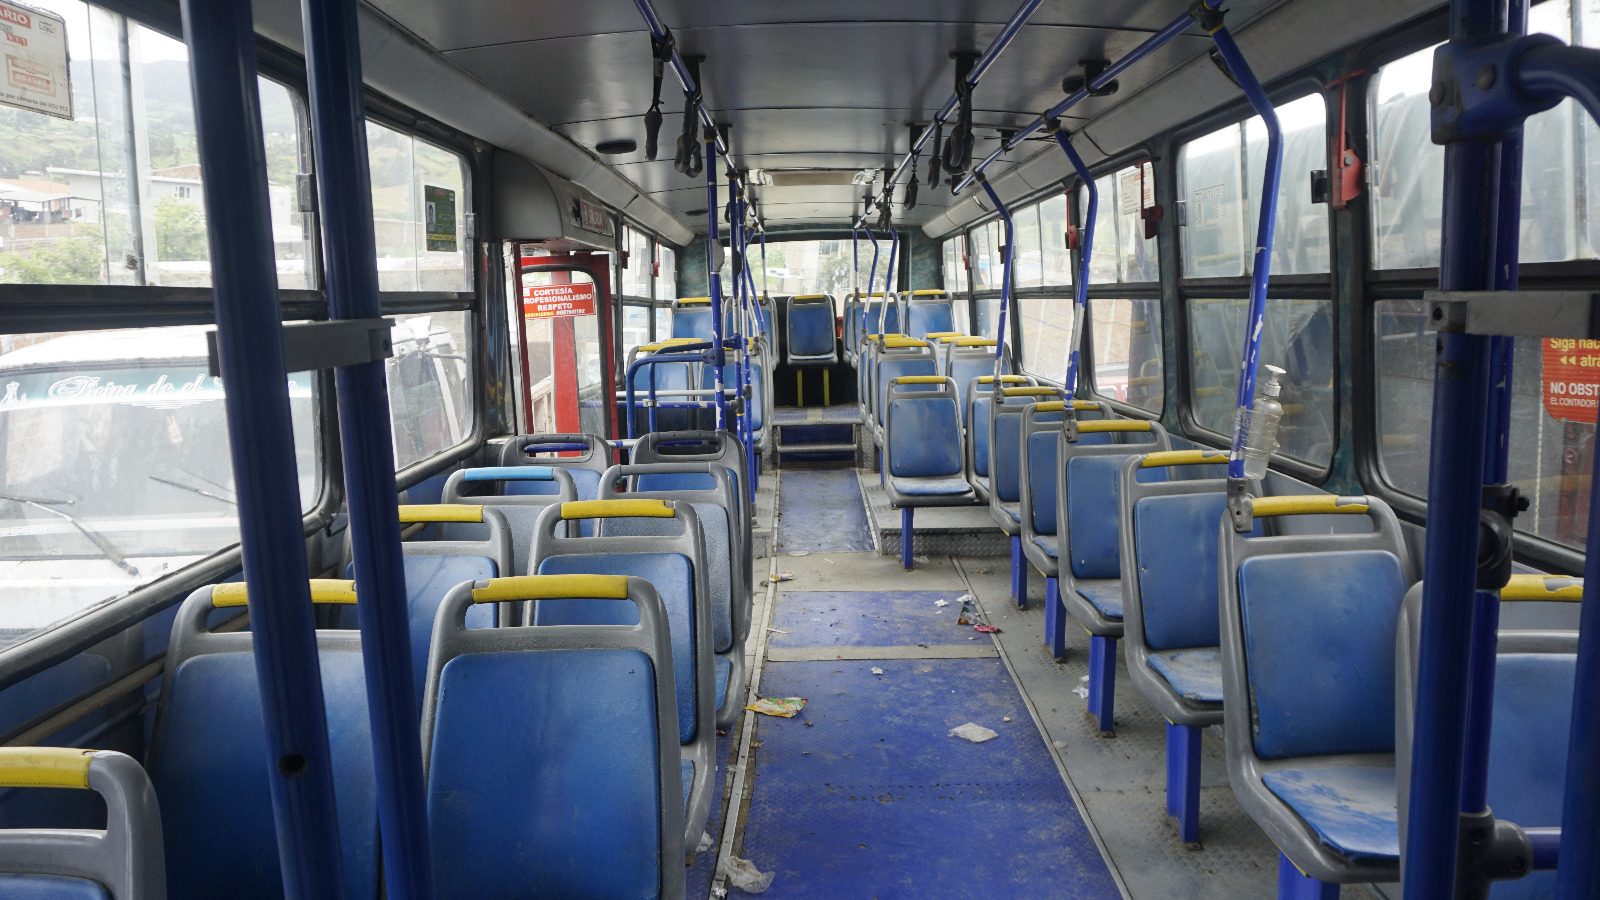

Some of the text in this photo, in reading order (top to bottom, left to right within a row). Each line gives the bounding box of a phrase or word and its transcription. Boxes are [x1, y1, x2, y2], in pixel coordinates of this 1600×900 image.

[523, 293, 592, 305] ROFESIONALISMO
[537, 302, 573, 312] RESPETO
[1550, 338, 1575, 352] Siga
[1550, 382, 1567, 395] NO
[1559, 397, 1596, 408] CONTADOR
